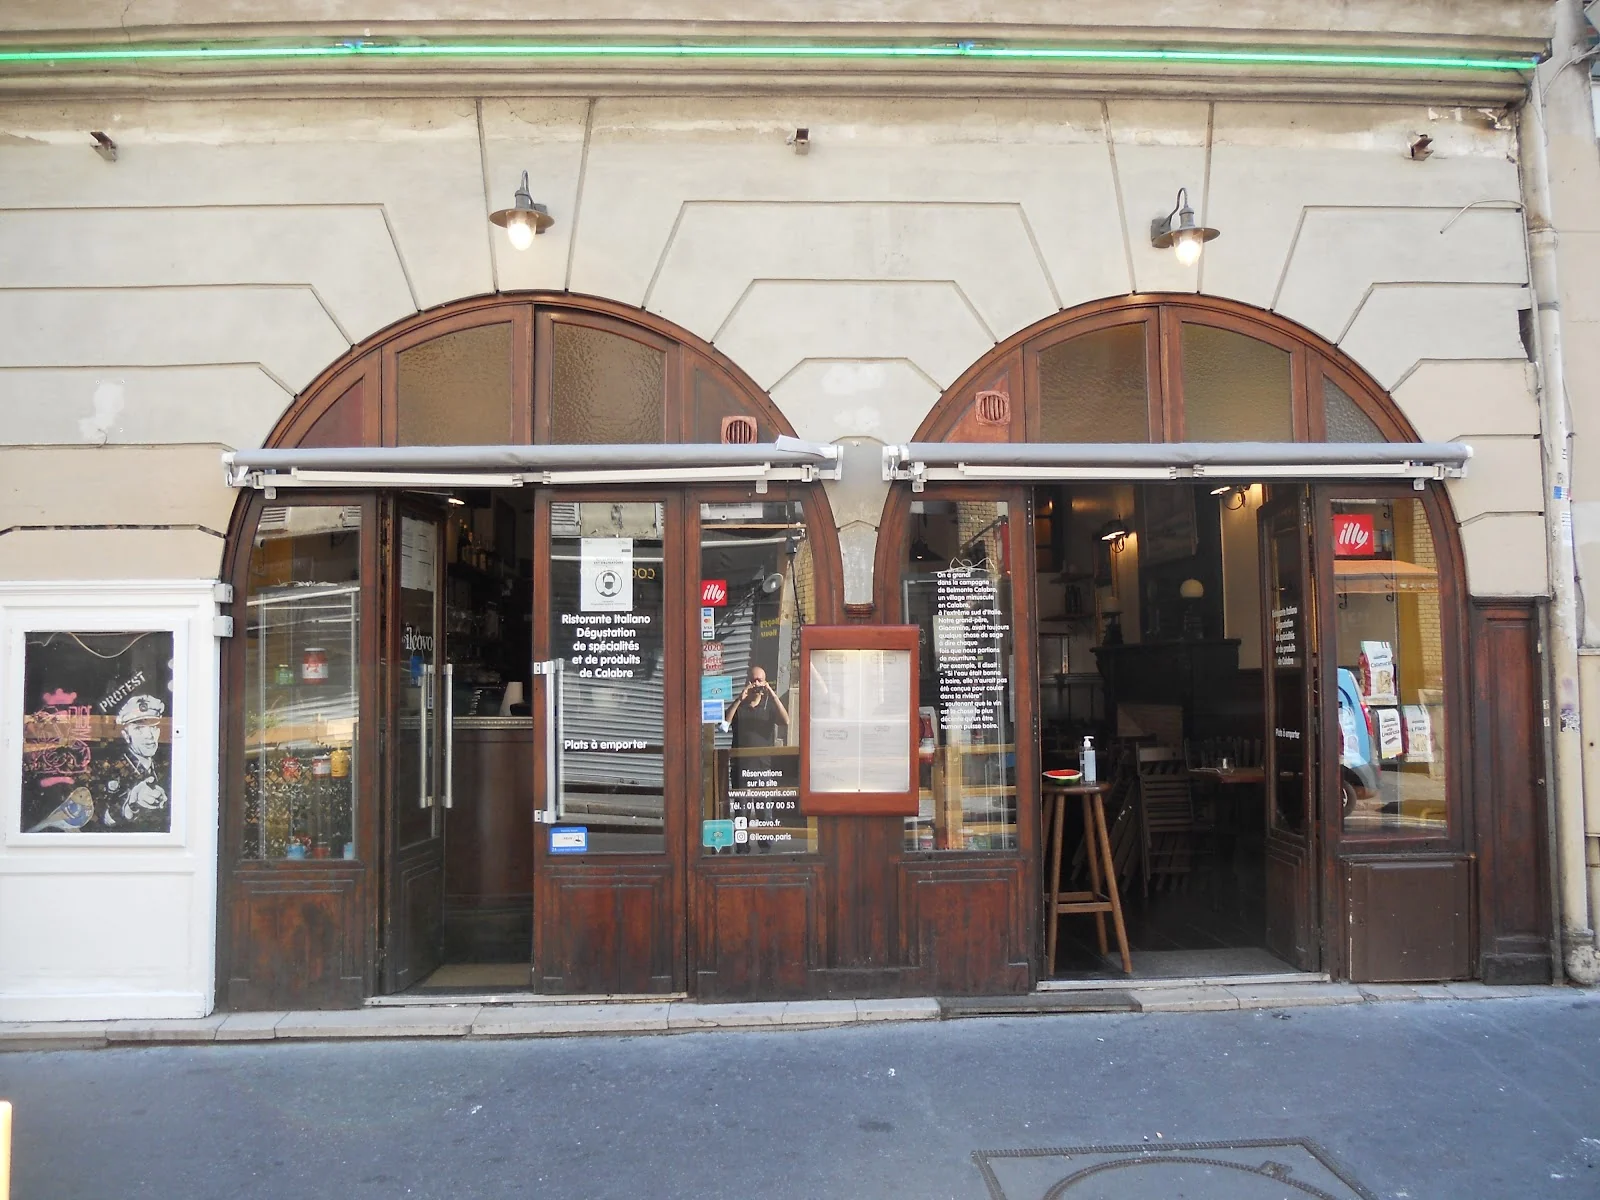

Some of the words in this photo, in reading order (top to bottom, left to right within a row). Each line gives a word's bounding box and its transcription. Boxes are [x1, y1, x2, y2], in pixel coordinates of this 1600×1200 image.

[1339, 522, 1368, 549] illy
[703, 583, 725, 603] illy
[561, 614, 612, 624] Ristorante
[614, 614, 651, 624] Italiano
[576, 627, 636, 640] Dégustation
[572, 641, 586, 651] de
[588, 640, 640, 653] spécialités
[572, 655, 583, 664] et
[584, 654, 598, 664] de
[600, 654, 641, 666] produits
[579, 668, 592, 678] de
[594, 668, 633, 678] Calabre
[99, 671, 146, 712] PROTEST
[564, 740, 589, 750] Plats
[591, 739, 598, 749] à
[600, 740, 648, 751] emporter
[758, 779, 765, 787] le
[766, 779, 778, 787] site
[728, 790, 797, 798] www.ilcovoparis.com
[730, 802, 741, 810] Tél.
[749, 819, 780, 827] @ilcovo.fr
[749, 833, 792, 842] @ilcovo.paris
